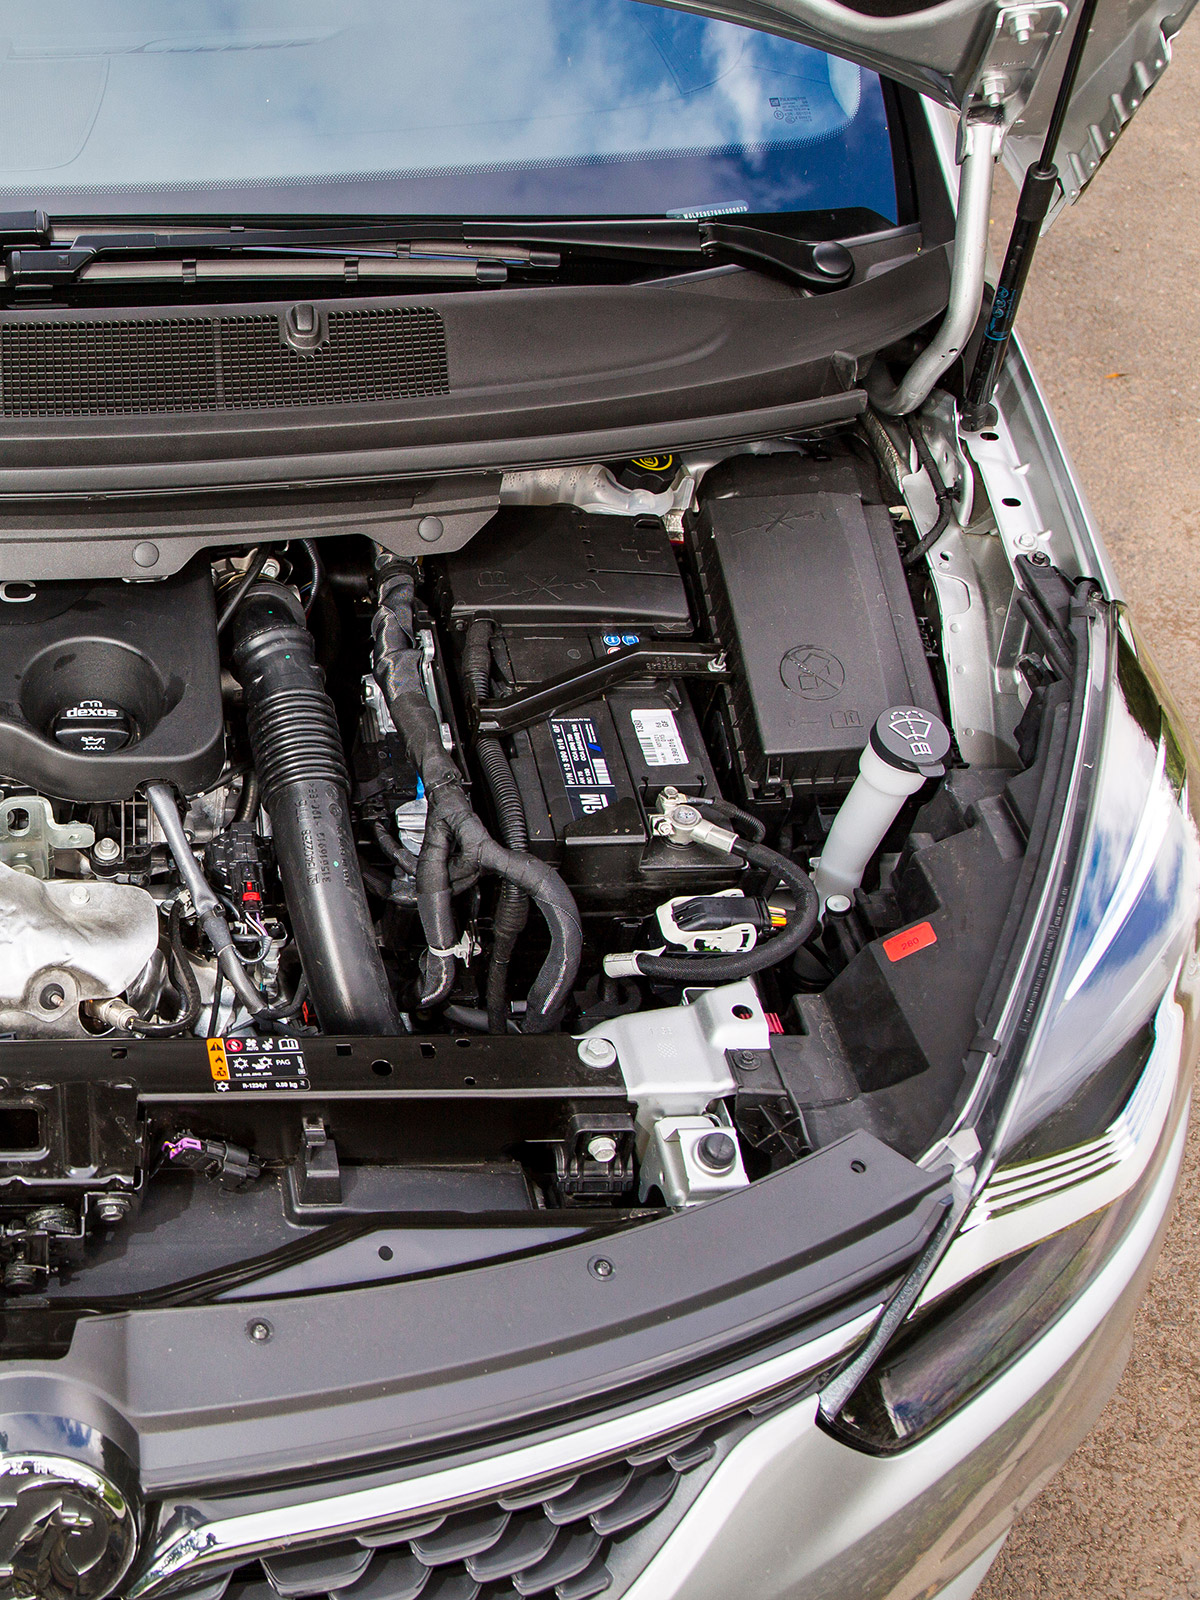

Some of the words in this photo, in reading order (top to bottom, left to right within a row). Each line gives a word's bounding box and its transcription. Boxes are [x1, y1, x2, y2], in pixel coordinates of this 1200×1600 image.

[66, 707, 119, 718] dexos
[579, 793, 604, 815] GM
[901, 937, 919, 951] 280
[289, 1081, 298, 1089] kg
